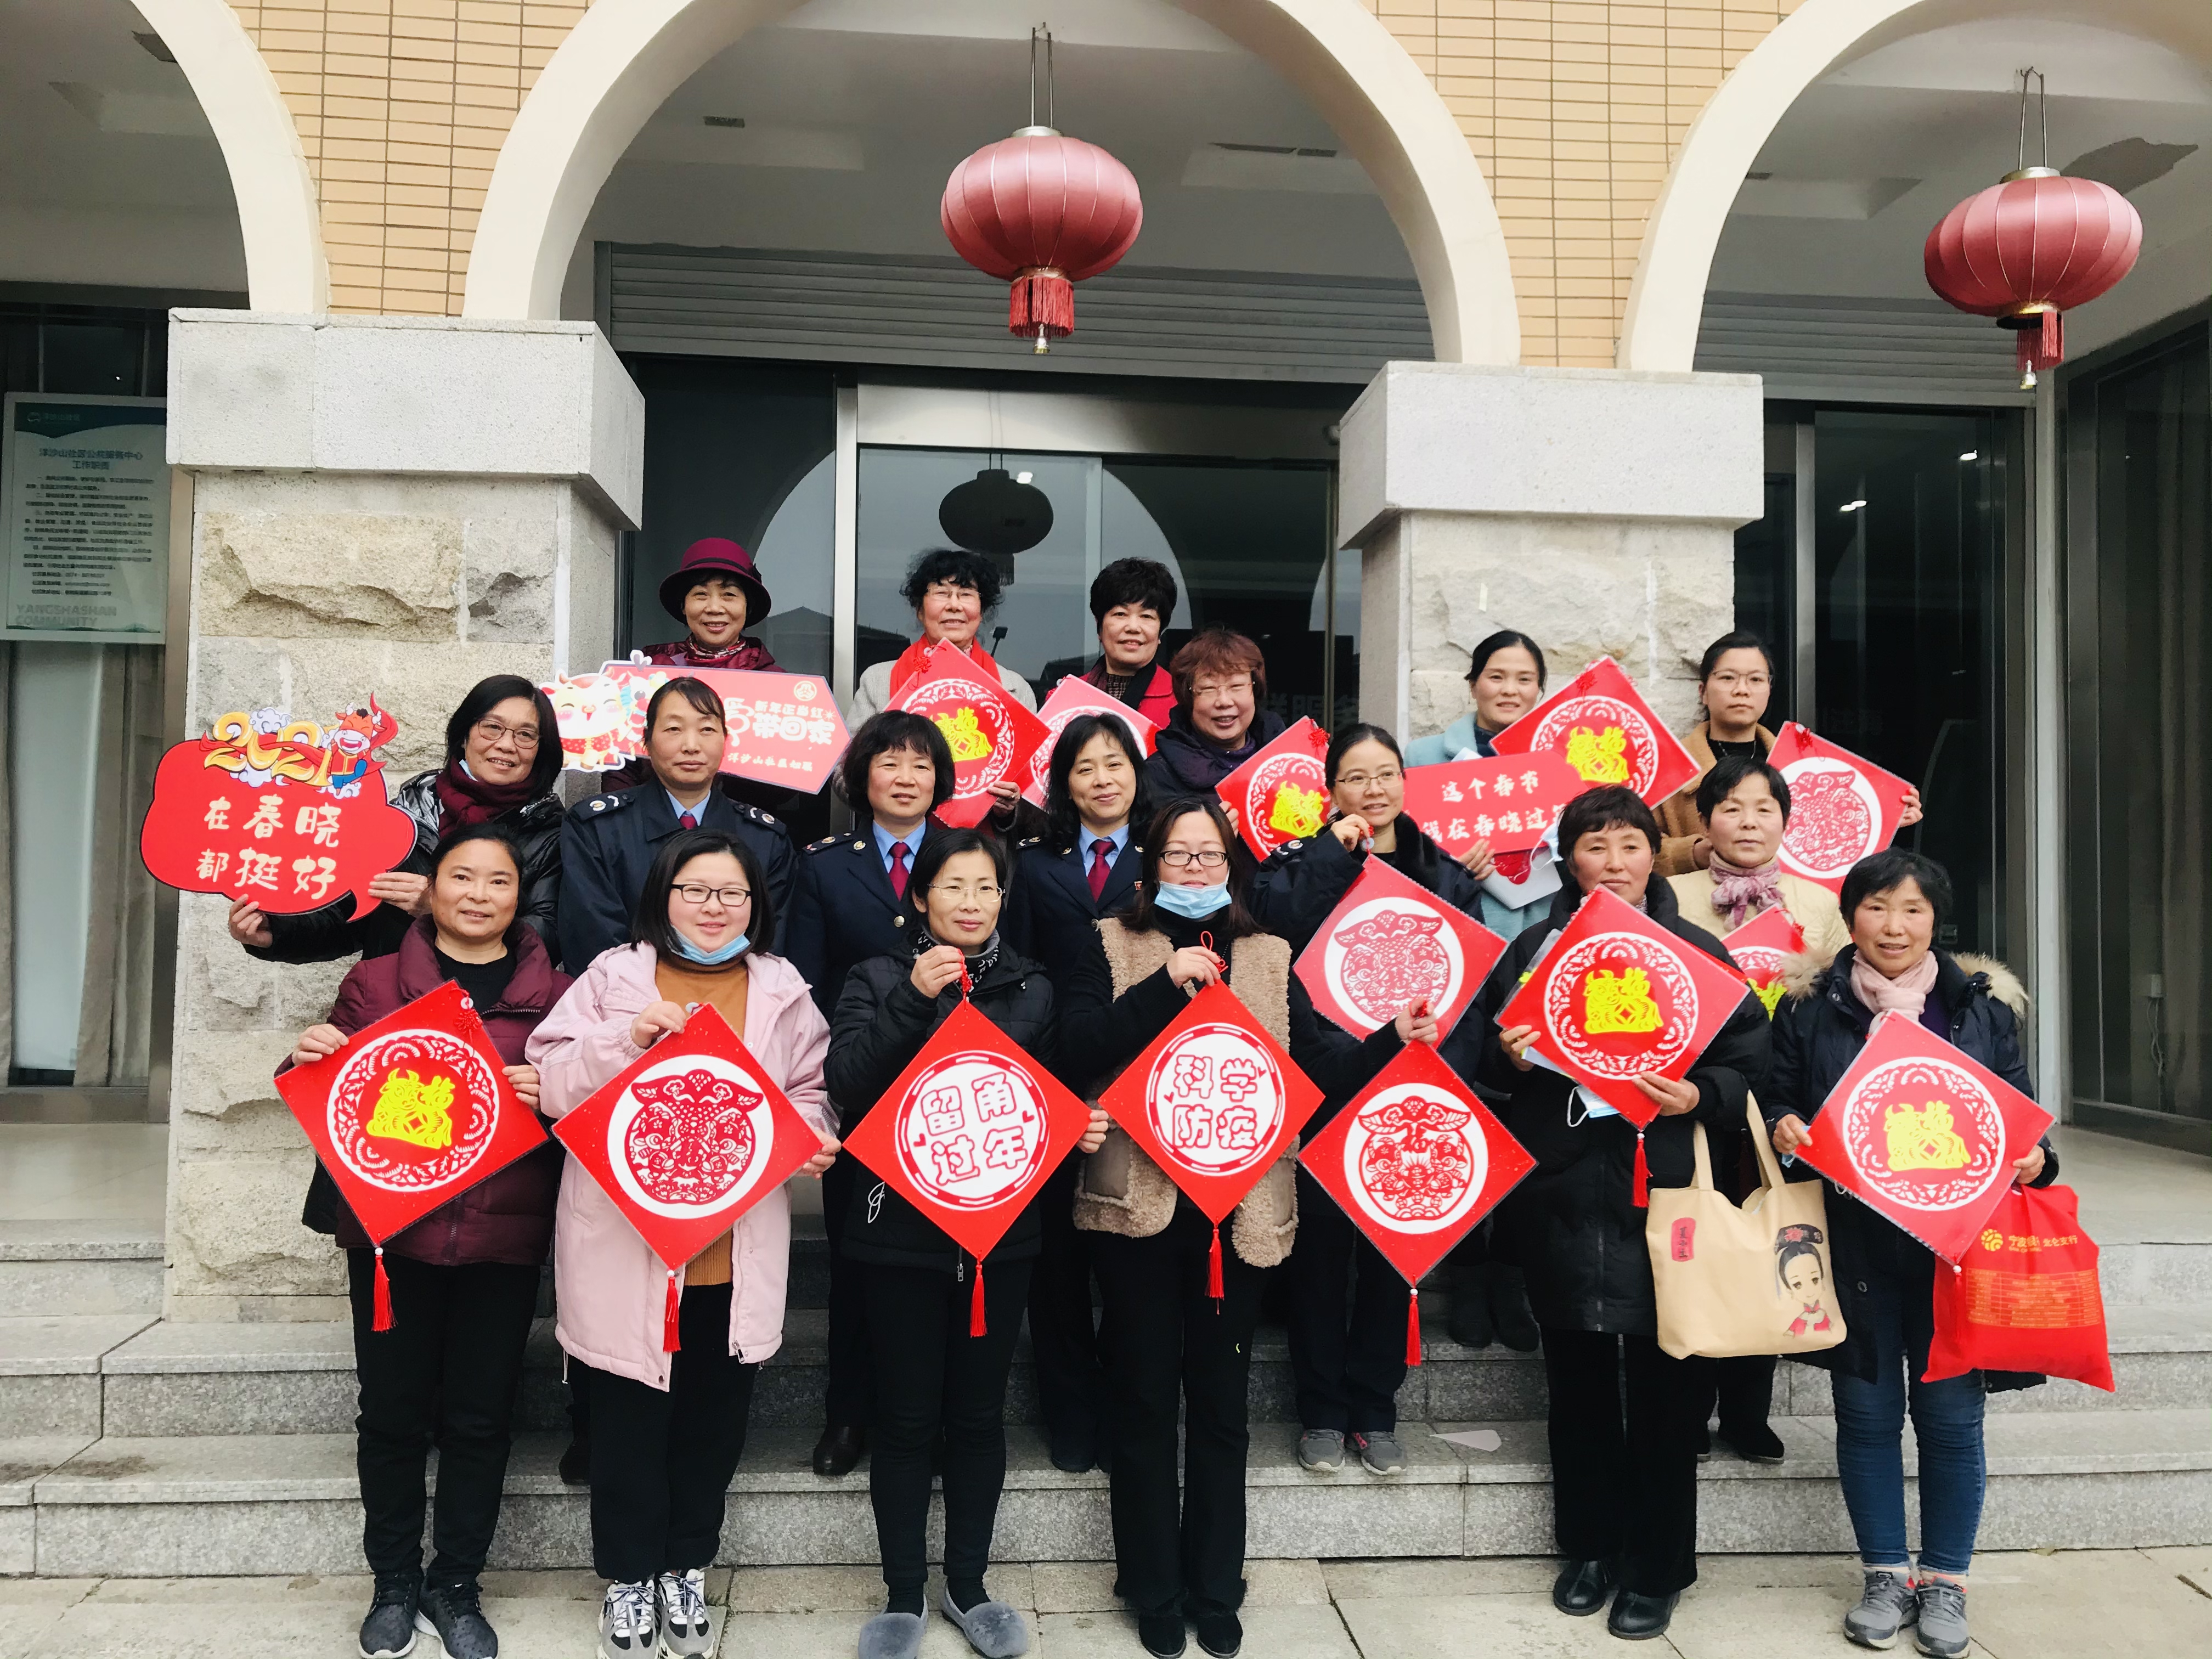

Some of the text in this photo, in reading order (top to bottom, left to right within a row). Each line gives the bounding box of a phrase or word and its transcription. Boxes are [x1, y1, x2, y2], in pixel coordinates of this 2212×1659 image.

[15, 614, 98, 627] COMMUNITY
[754, 700, 824, 719] 新年正当红
[1441, 770, 1539, 803] 这个春节
[204, 793, 342, 848] 在春晓
[195, 847, 337, 900] 都挺好
[1173, 1054, 1257, 1103] 科学
[920, 1071, 1018, 1136] 留甬
[1172, 1104, 1259, 1150] 防疫
[930, 1126, 1029, 1186] 过年
